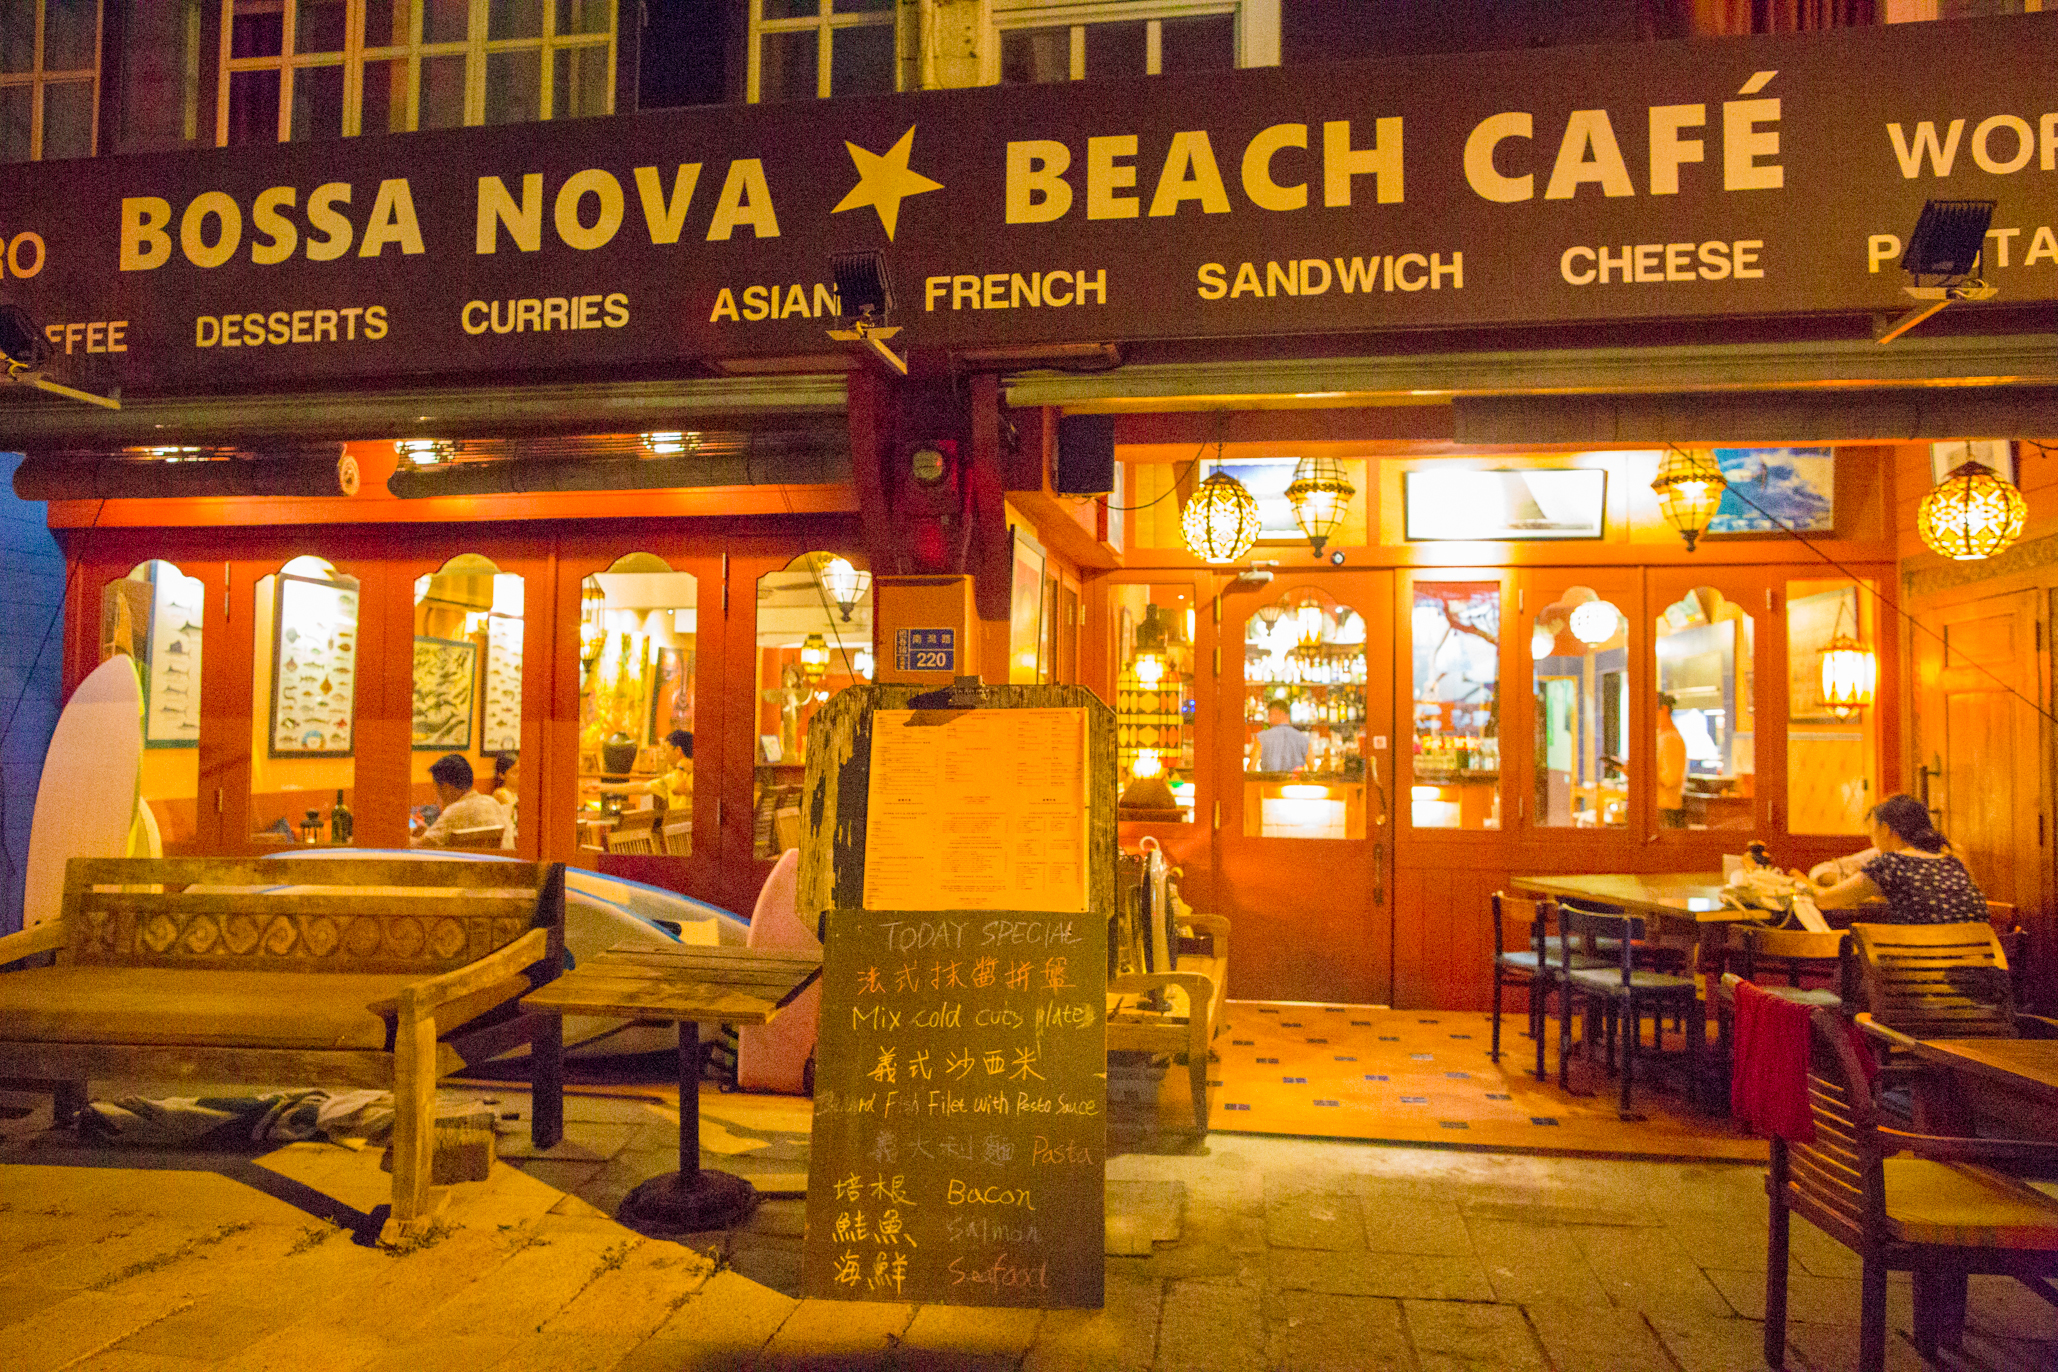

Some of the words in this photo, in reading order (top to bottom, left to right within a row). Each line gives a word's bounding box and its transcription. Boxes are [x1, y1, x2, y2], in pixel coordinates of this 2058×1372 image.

[120, 178, 425, 271] BOSSA
[476, 159, 780, 254] NOVA
[1006, 117, 1404, 224] BEACH
[1464, 71, 1784, 203] CAFÉ
[0, 231, 46, 279] O
[1561, 240, 1765, 285] CHEESE
[1868, 226, 2058, 274] PTA
[926, 270, 1107, 312] FRENCH
[1198, 251, 1464, 299] SANDWICH
[462, 293, 630, 334] CURRIES
[710, 283, 842, 322] ASIAN
[45, 320, 129, 355] FFEE
[196, 306, 388, 347] DESSERTS
[916, 652, 947, 667] 220
[879, 921, 969, 952] TODAY
[981, 920, 1083, 949] SPECIAL
[853, 1003, 902, 1031] Mix
[914, 1001, 962, 1029] cold
[927, 1090, 968, 1116] Filet
[1056, 1093, 1100, 1117] Sauce
[1031, 1134, 1094, 1167] Pasta
[833, 1172, 919, 1207] 培根
[946, 1179, 1036, 1210] Bacon
[831, 1208, 918, 1248] 鮭魚
[945, 1216, 1042, 1246] Salmon
[833, 1248, 909, 1294] 海鮮
[947, 1252, 1049, 1293] Seafood
